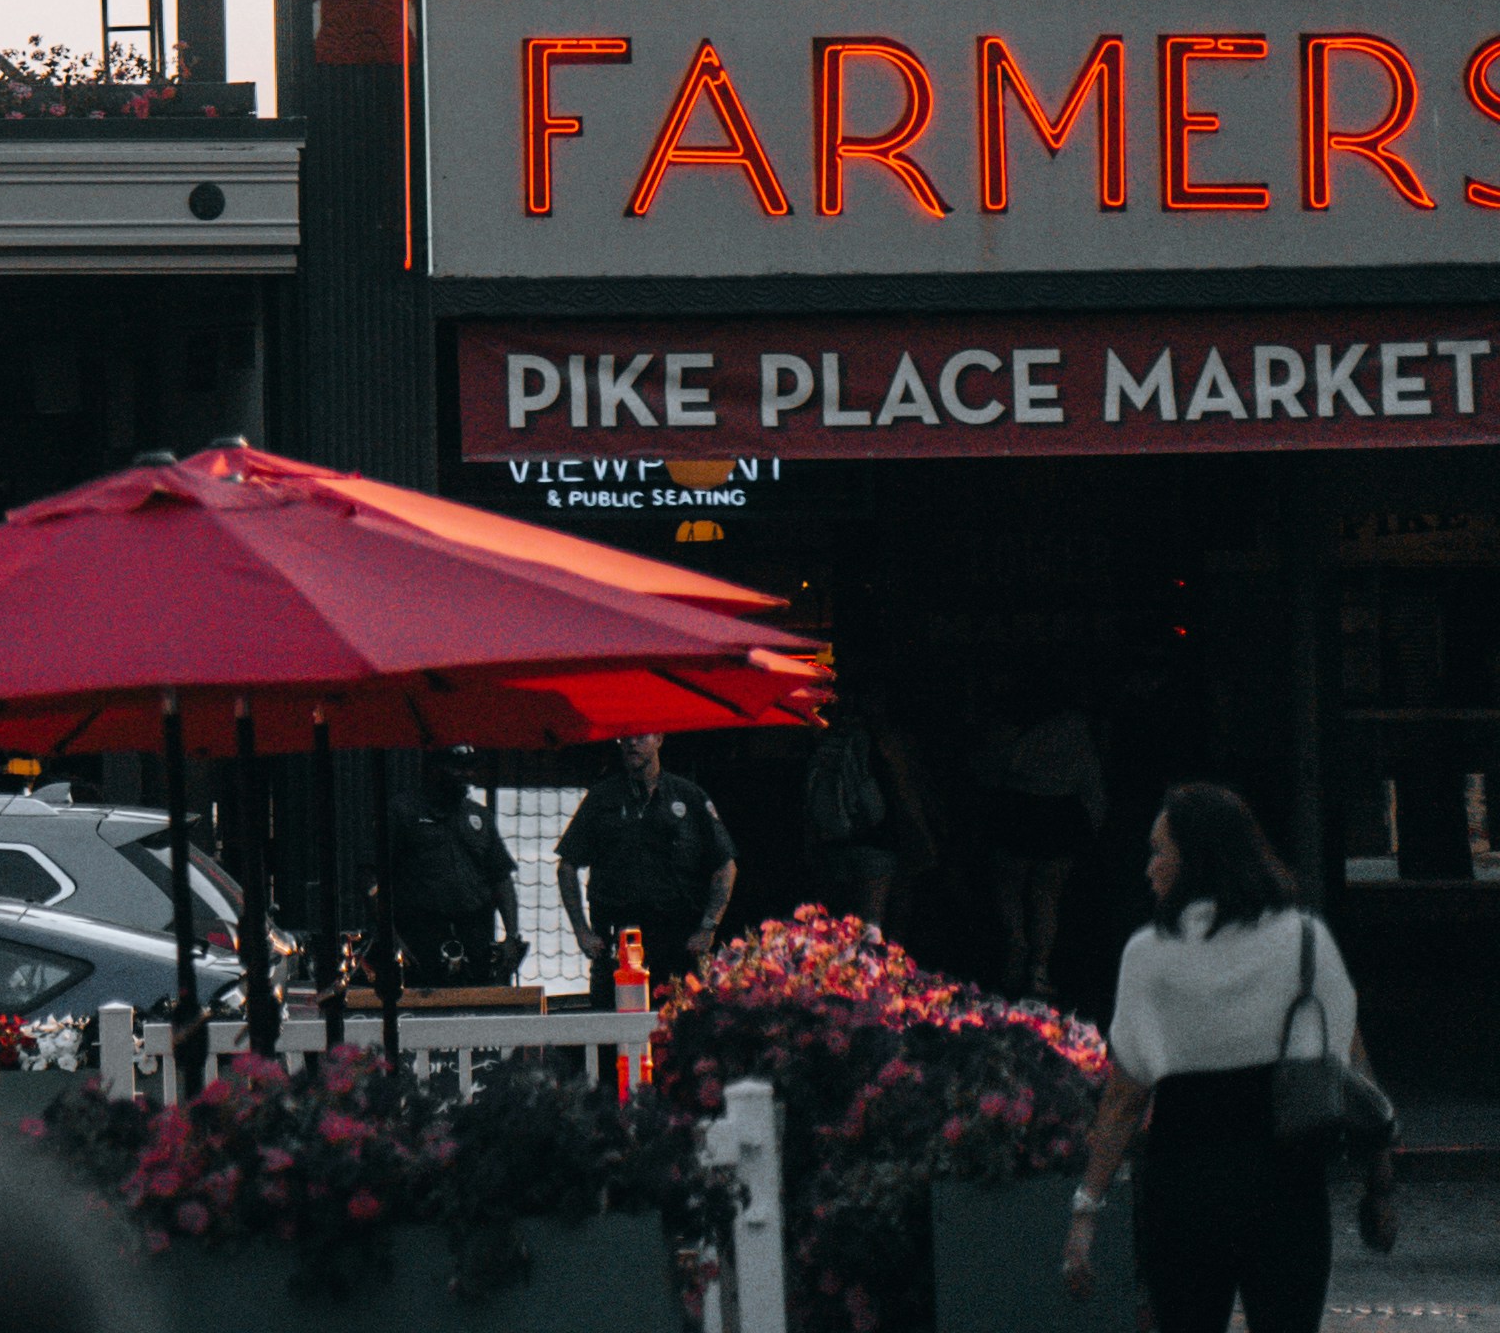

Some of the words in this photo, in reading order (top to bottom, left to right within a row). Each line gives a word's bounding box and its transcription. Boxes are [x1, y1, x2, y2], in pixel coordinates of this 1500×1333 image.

[506, 351, 717, 430] PIKE
[760, 347, 1065, 427] PLACE
[1103, 339, 1493, 424] MARKET
[547, 489, 563, 508] &
[568, 490, 645, 508] PUBLIC
[651, 489, 747, 507] SEATING
